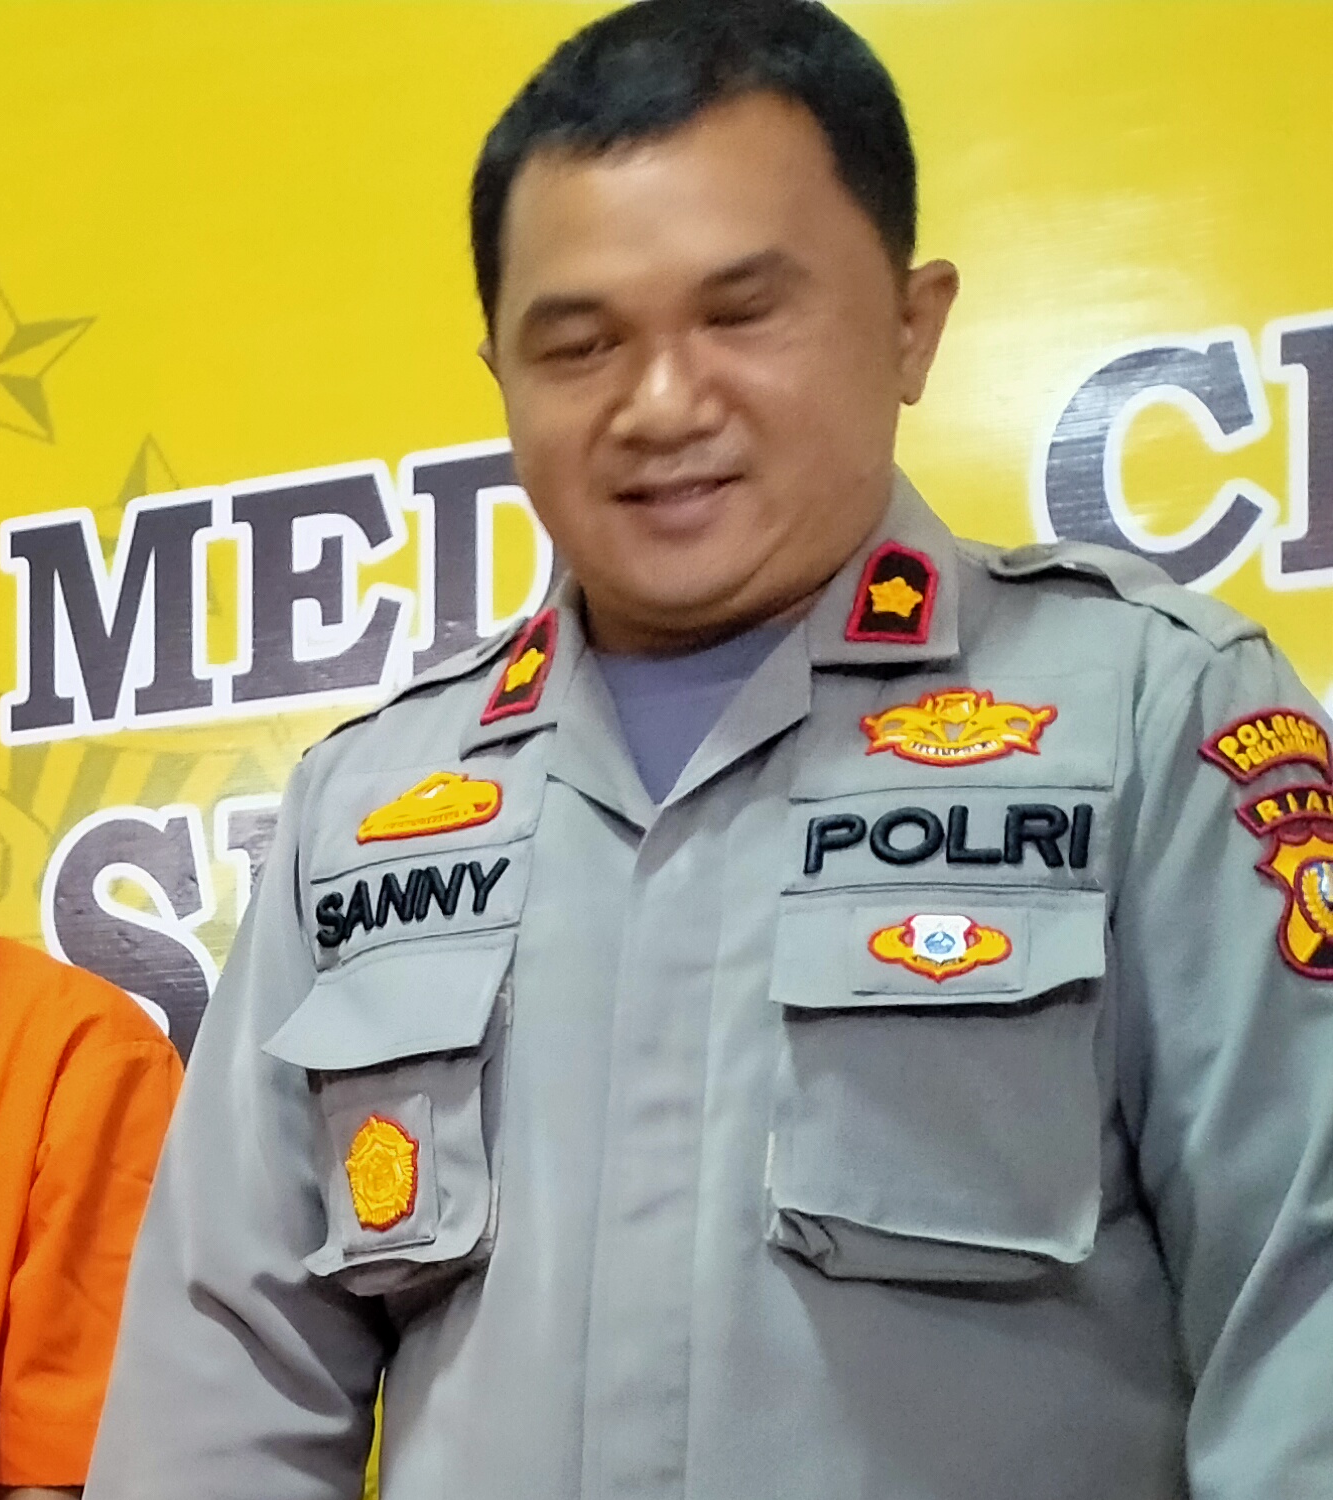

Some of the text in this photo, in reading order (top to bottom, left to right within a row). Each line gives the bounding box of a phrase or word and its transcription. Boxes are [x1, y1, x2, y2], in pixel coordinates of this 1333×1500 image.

[5, 447, 541, 736] MED
[803, 803, 1094, 875] POLRI
[316, 857, 511, 949] SANNY
